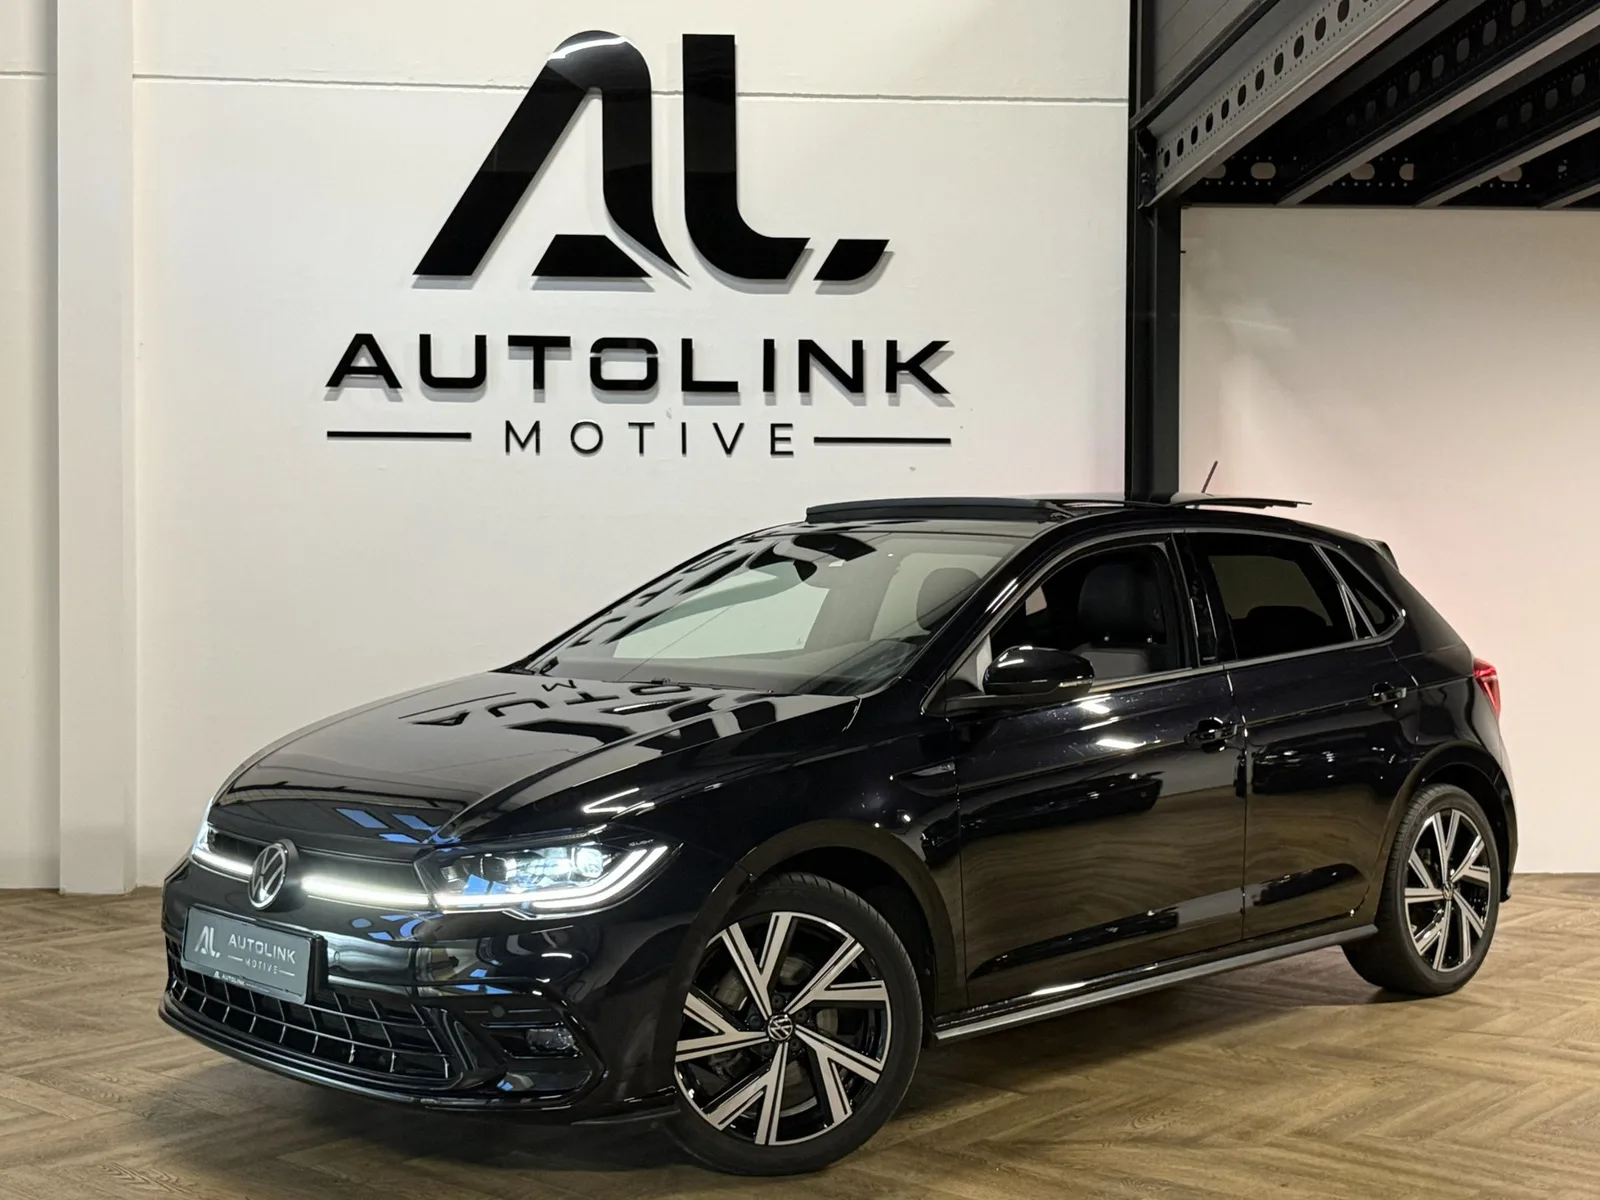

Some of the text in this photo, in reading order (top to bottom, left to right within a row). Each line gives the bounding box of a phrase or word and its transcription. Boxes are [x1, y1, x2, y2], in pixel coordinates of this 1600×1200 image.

[325, 332, 951, 395] AUTOLINK
[504, 420, 795, 456] MOTIVE
[228, 934, 296, 965] AUTOLINK
[245, 957, 279, 975] MOTIVE
